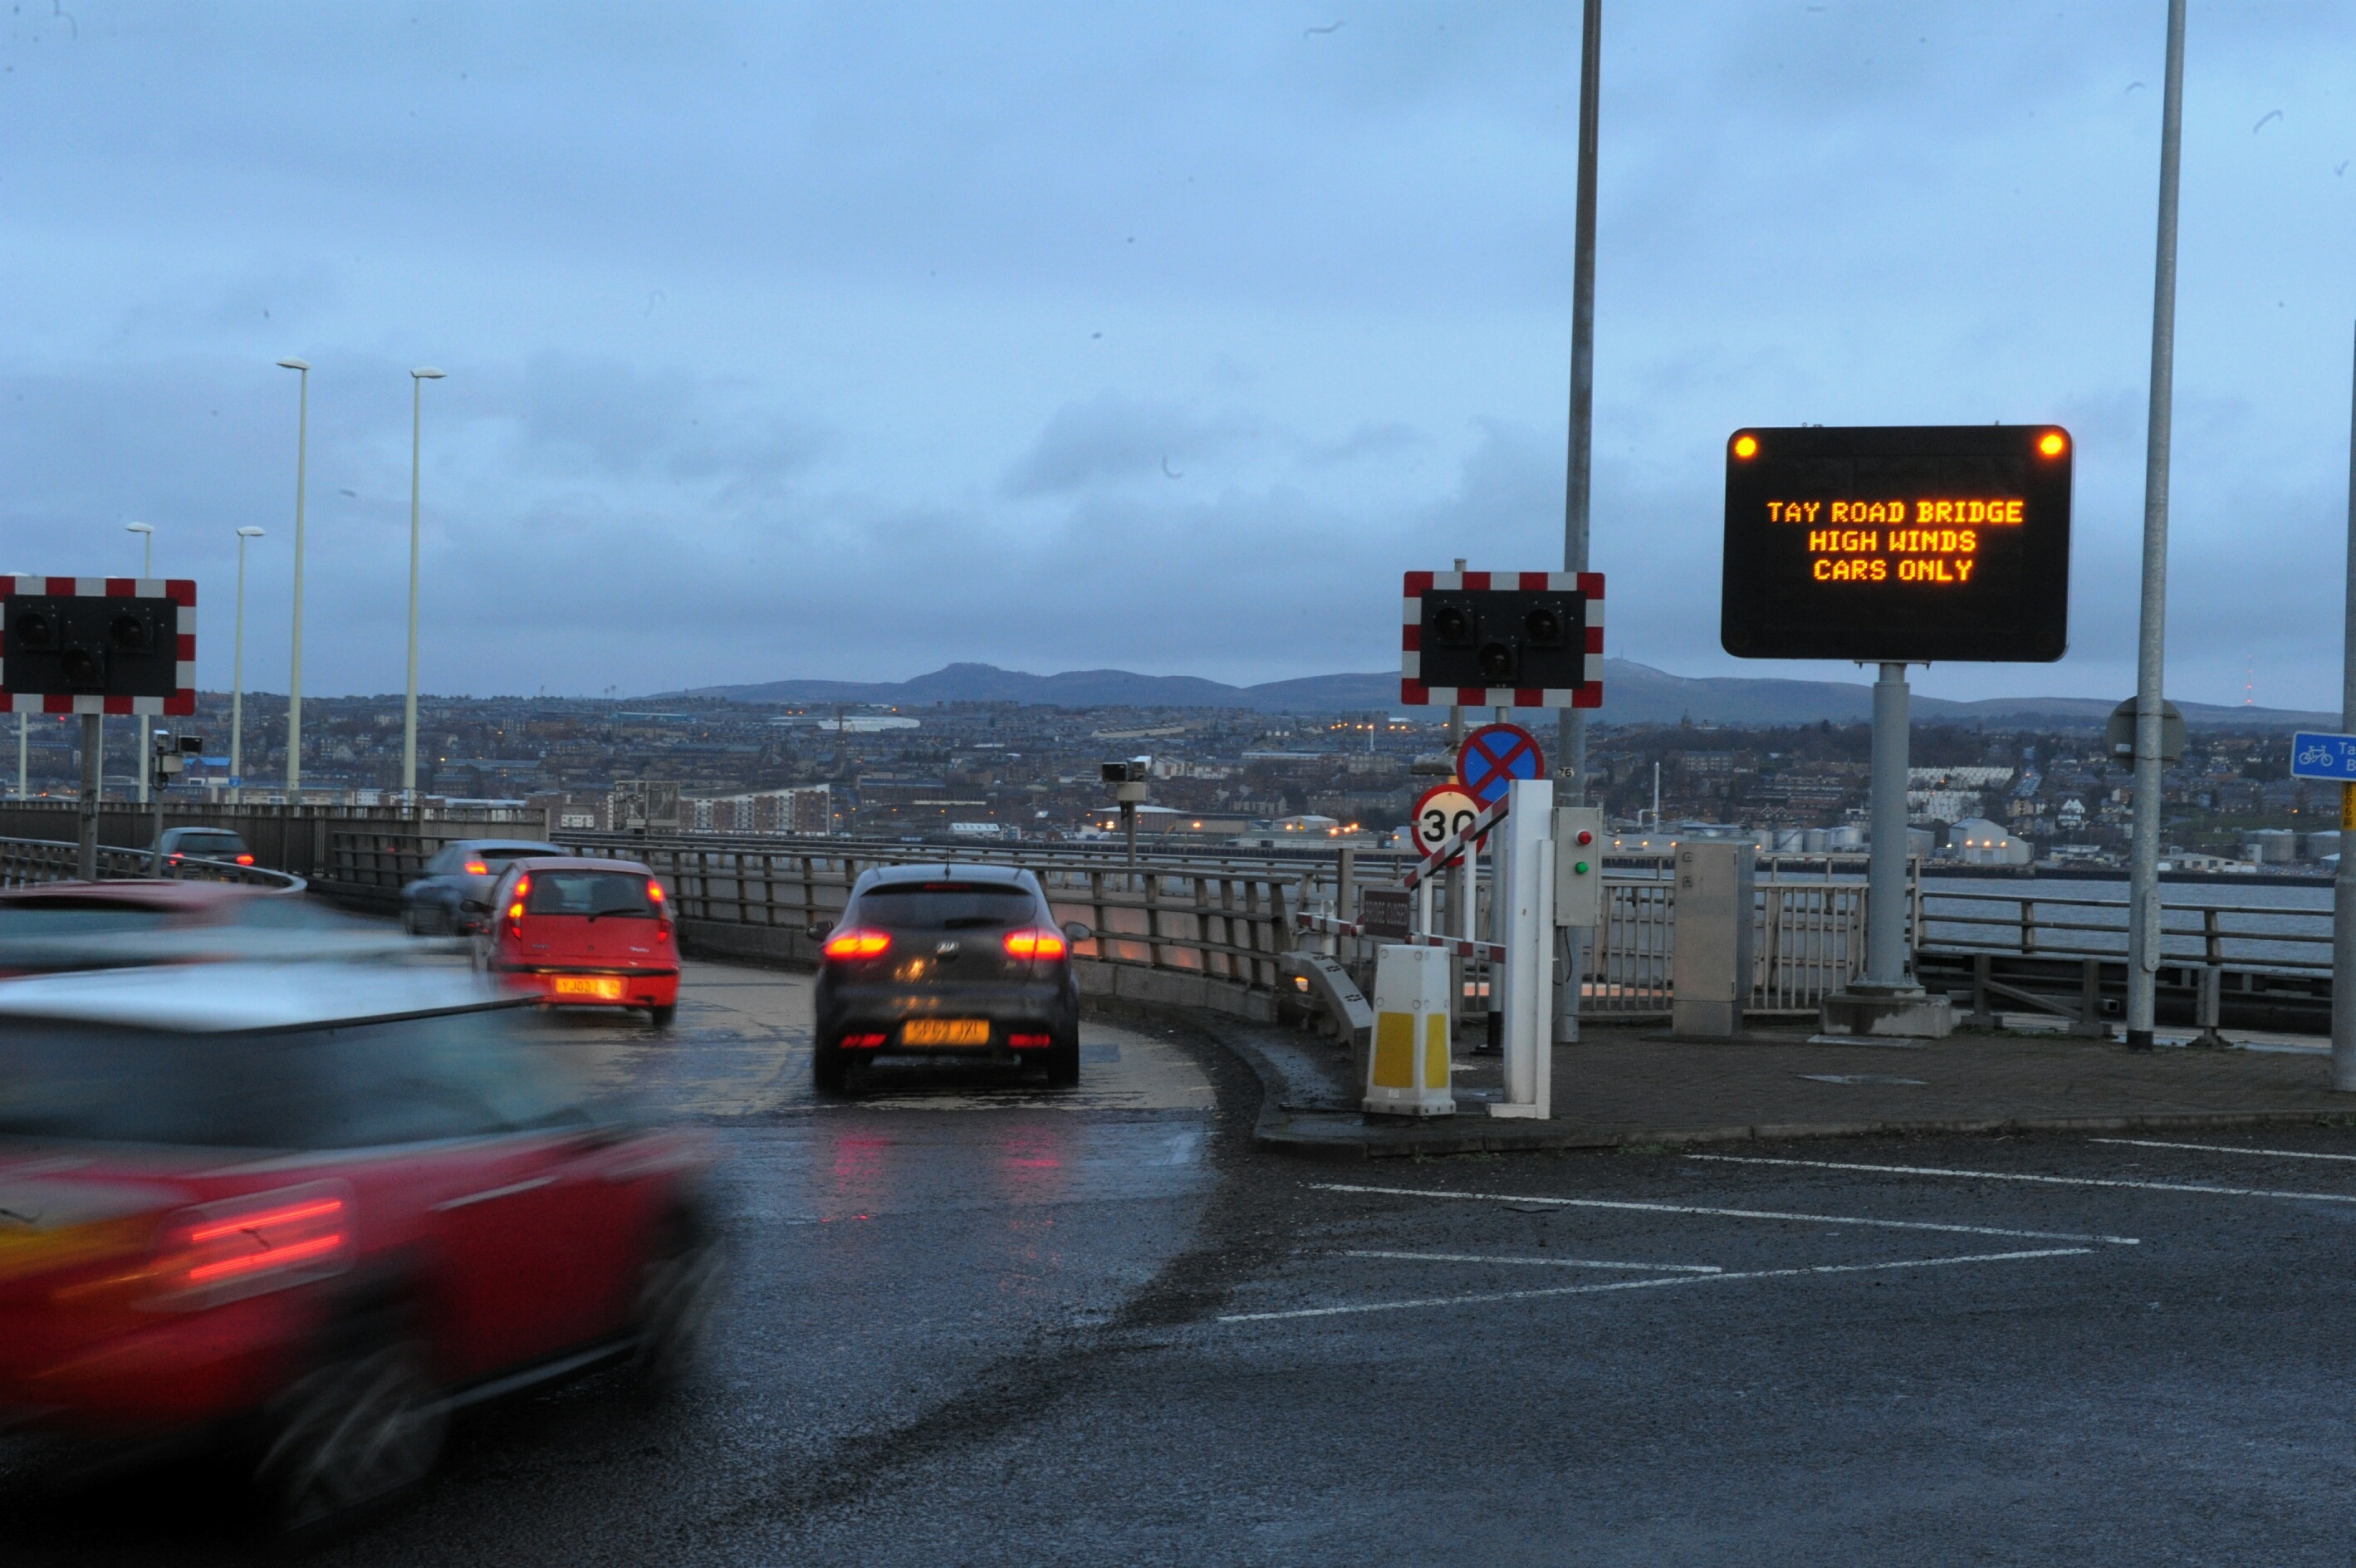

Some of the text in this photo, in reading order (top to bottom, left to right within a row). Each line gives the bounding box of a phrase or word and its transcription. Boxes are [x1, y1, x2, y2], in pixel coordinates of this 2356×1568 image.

[1766, 500, 2025, 523] TAY ROAD BRIDGE
[1809, 530, 1976, 552] HIGH WINDS
[1813, 559, 1973, 581] CARS ONLY
[1559, 767, 1572, 777] 76
[1423, 809, 1477, 843] 30
